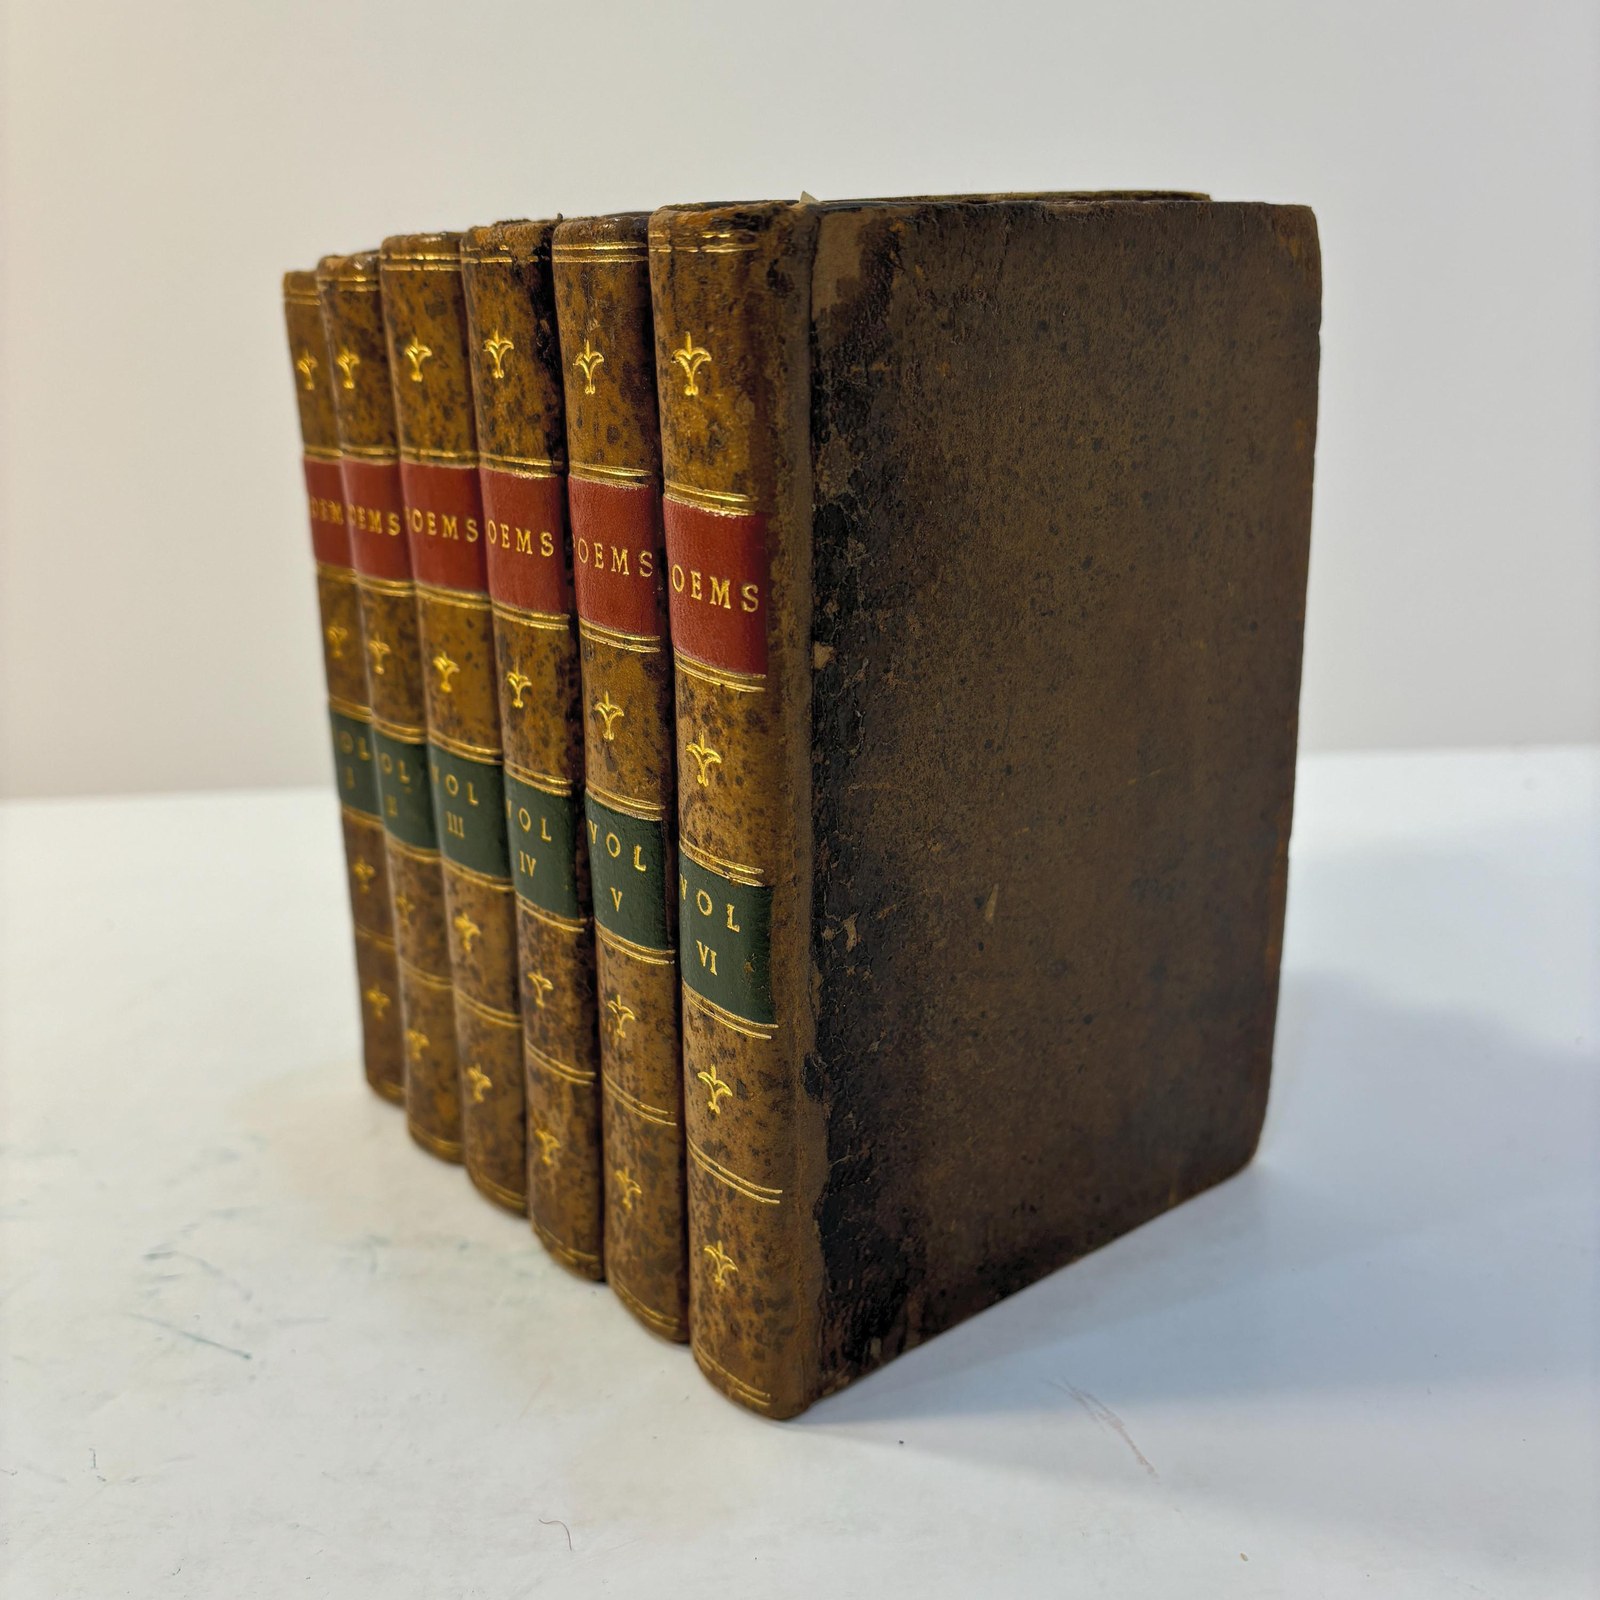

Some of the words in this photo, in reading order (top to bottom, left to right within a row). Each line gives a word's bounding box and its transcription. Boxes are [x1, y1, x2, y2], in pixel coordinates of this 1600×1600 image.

[347, 503, 401, 536] OEMS
[487, 519, 555, 557] OEMS
[671, 563, 759, 612] OEMS
[380, 752, 411, 784] OL
[445, 811, 465, 840] III
[589, 820, 647, 872] VOL
[519, 850, 537, 877] IV
[610, 887, 623, 912] V
[696, 940, 717, 976] VI
